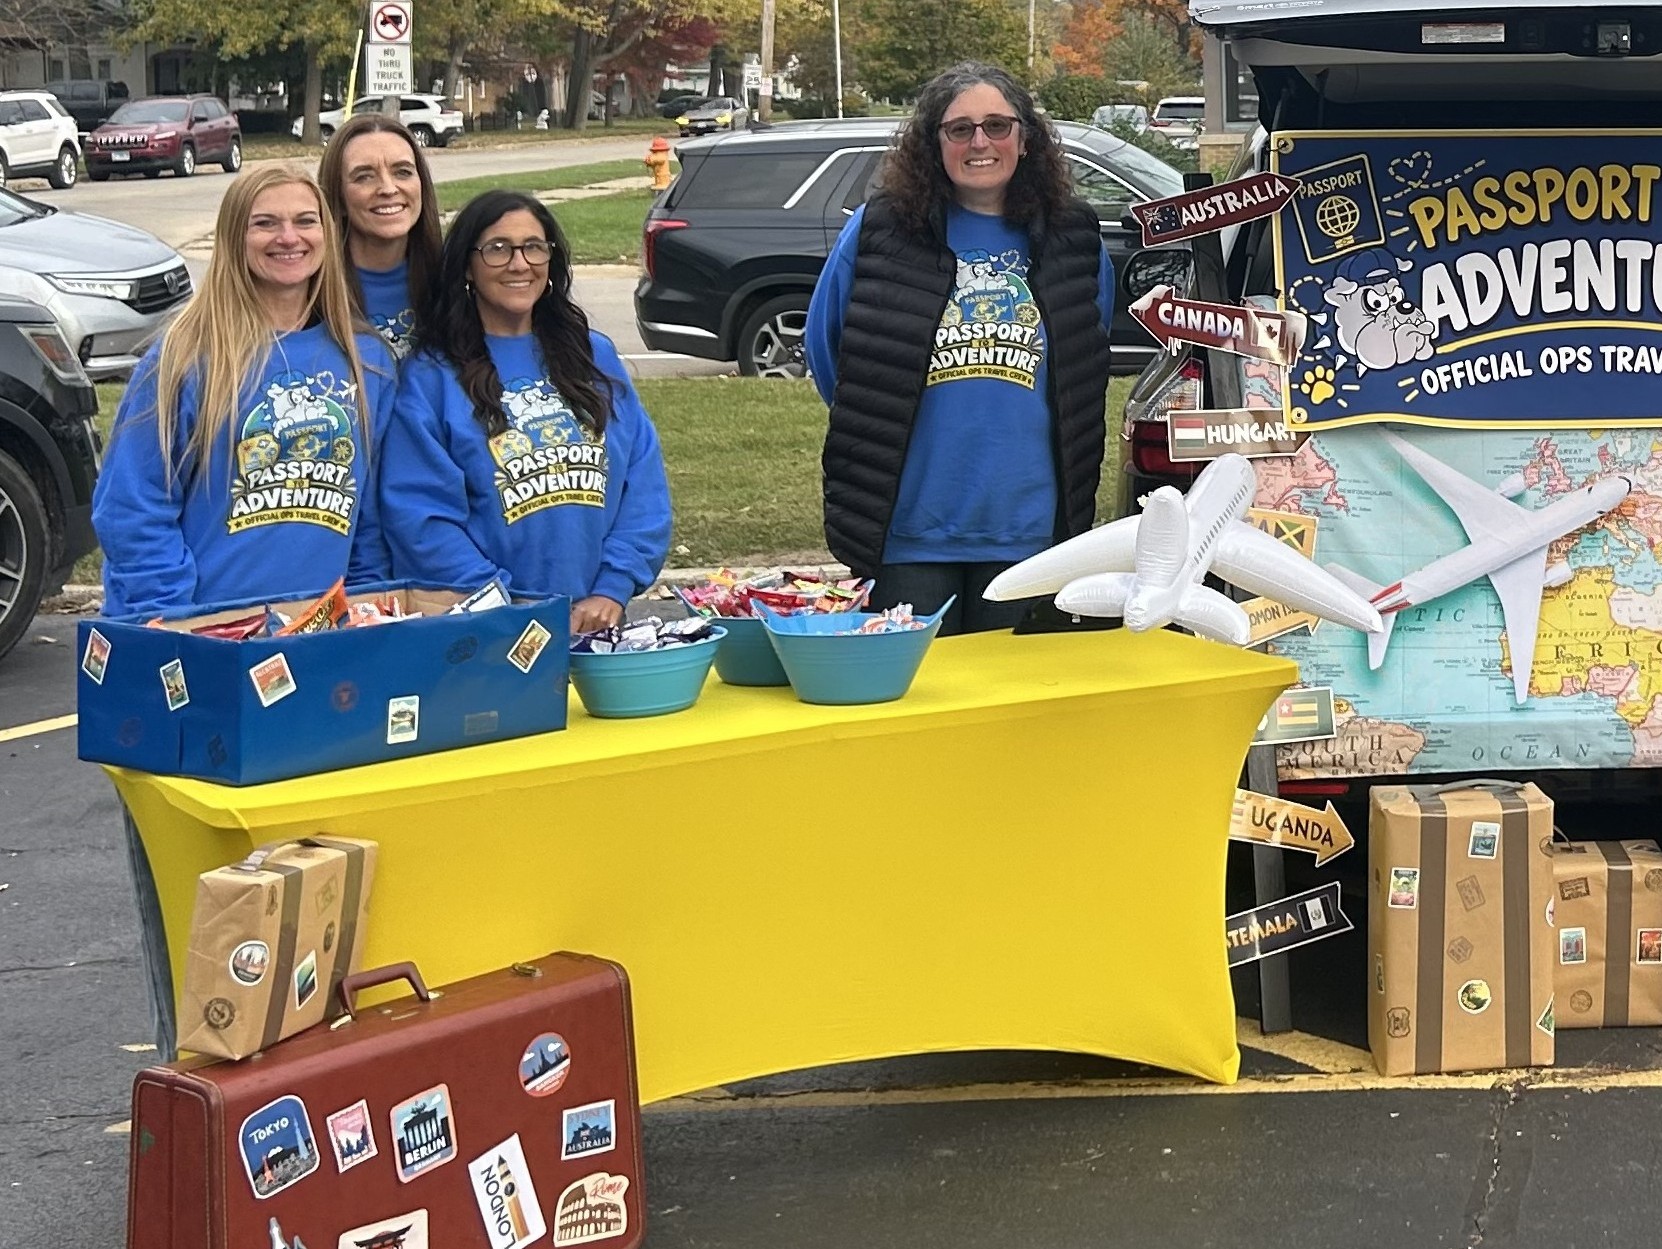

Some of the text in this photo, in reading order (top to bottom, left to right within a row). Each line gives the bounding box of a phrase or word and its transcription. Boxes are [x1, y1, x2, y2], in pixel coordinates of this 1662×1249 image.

[378, 60, 401, 68] THRU
[383, 48, 396, 57] NO
[373, 82, 407, 91] TRAFFIC
[376, 71, 404, 80] TRUCK
[1299, 169, 1363, 200] PASSPORT
[1181, 176, 1290, 227] AUSTRALIA
[1408, 164, 1662, 249] PASSPORT
[935, 322, 1036, 348] PASSPORT
[1157, 302, 1245, 341] CANADA
[928, 347, 1041, 374] ADVENTURE
[938, 369, 966, 379] OFFICIAL
[1420, 350, 1533, 396] OFFICIAL
[1539, 345, 1593, 374] OPS
[247, 461, 349, 489] PASSPORT
[506, 446, 604, 480] PASSPORT
[232, 487, 354, 518] ADVENTURE
[519, 497, 549, 514] OFFICIAL
[244, 511, 279, 525] OFFICIAL
[280, 509, 294, 519] OPS
[1471, 742, 1591, 762] OCEAN
[1250, 805, 1335, 849] UGANDA
[249, 1116, 290, 1145] TOKYO
[403, 1136, 447, 1167] BERLIN
[566, 1136, 612, 1154] AUSTRALIA
[588, 1176, 625, 1201] Rome
[480, 1164, 517, 1249] LONDON
